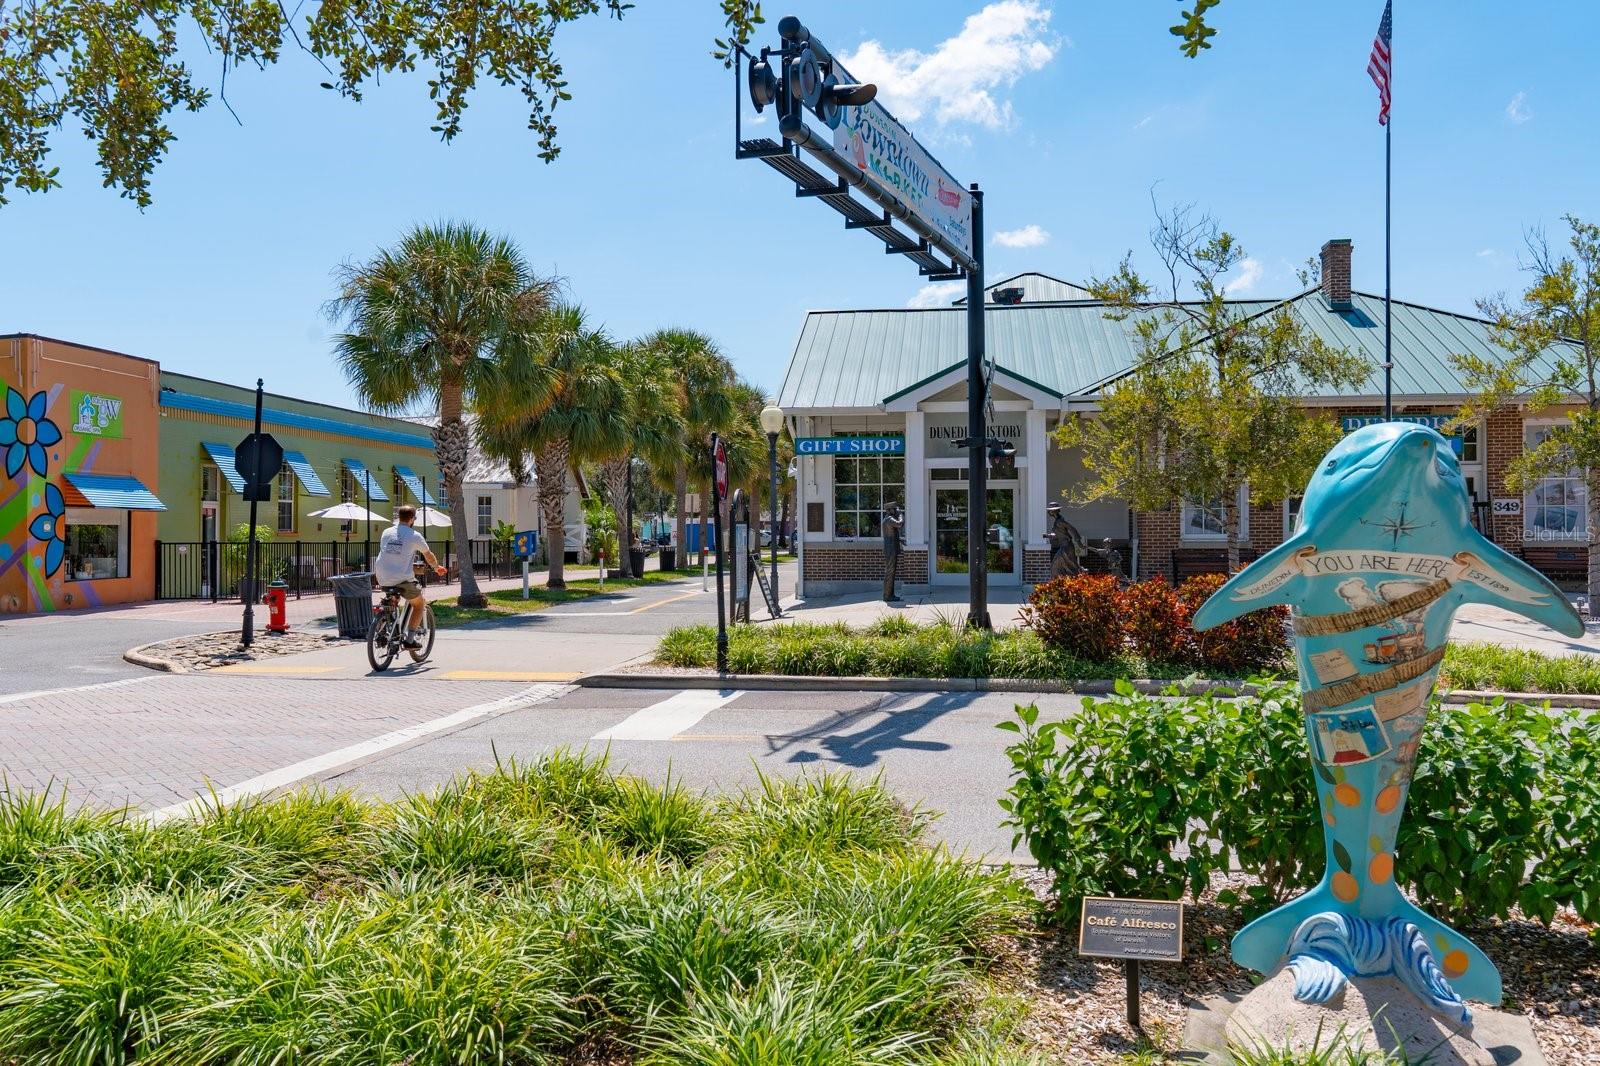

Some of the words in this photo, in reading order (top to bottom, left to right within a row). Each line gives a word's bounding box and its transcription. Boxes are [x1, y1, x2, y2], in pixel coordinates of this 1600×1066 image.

[930, 426, 967, 439] DUNEDI
[986, 425, 1022, 438] ISTORY
[800, 441, 844, 452] GIFT
[850, 439, 900, 451] SHOP
[1494, 501, 1520, 512] 349
[1305, 556, 1353, 574] YOU
[1360, 555, 1399, 571] ARE
[1405, 557, 1454, 578] HERE
[1249, 570, 1292, 594] DUNEDIN
[1087, 916, 1117, 926] Café
[1121, 918, 1177, 930] Alfresco
